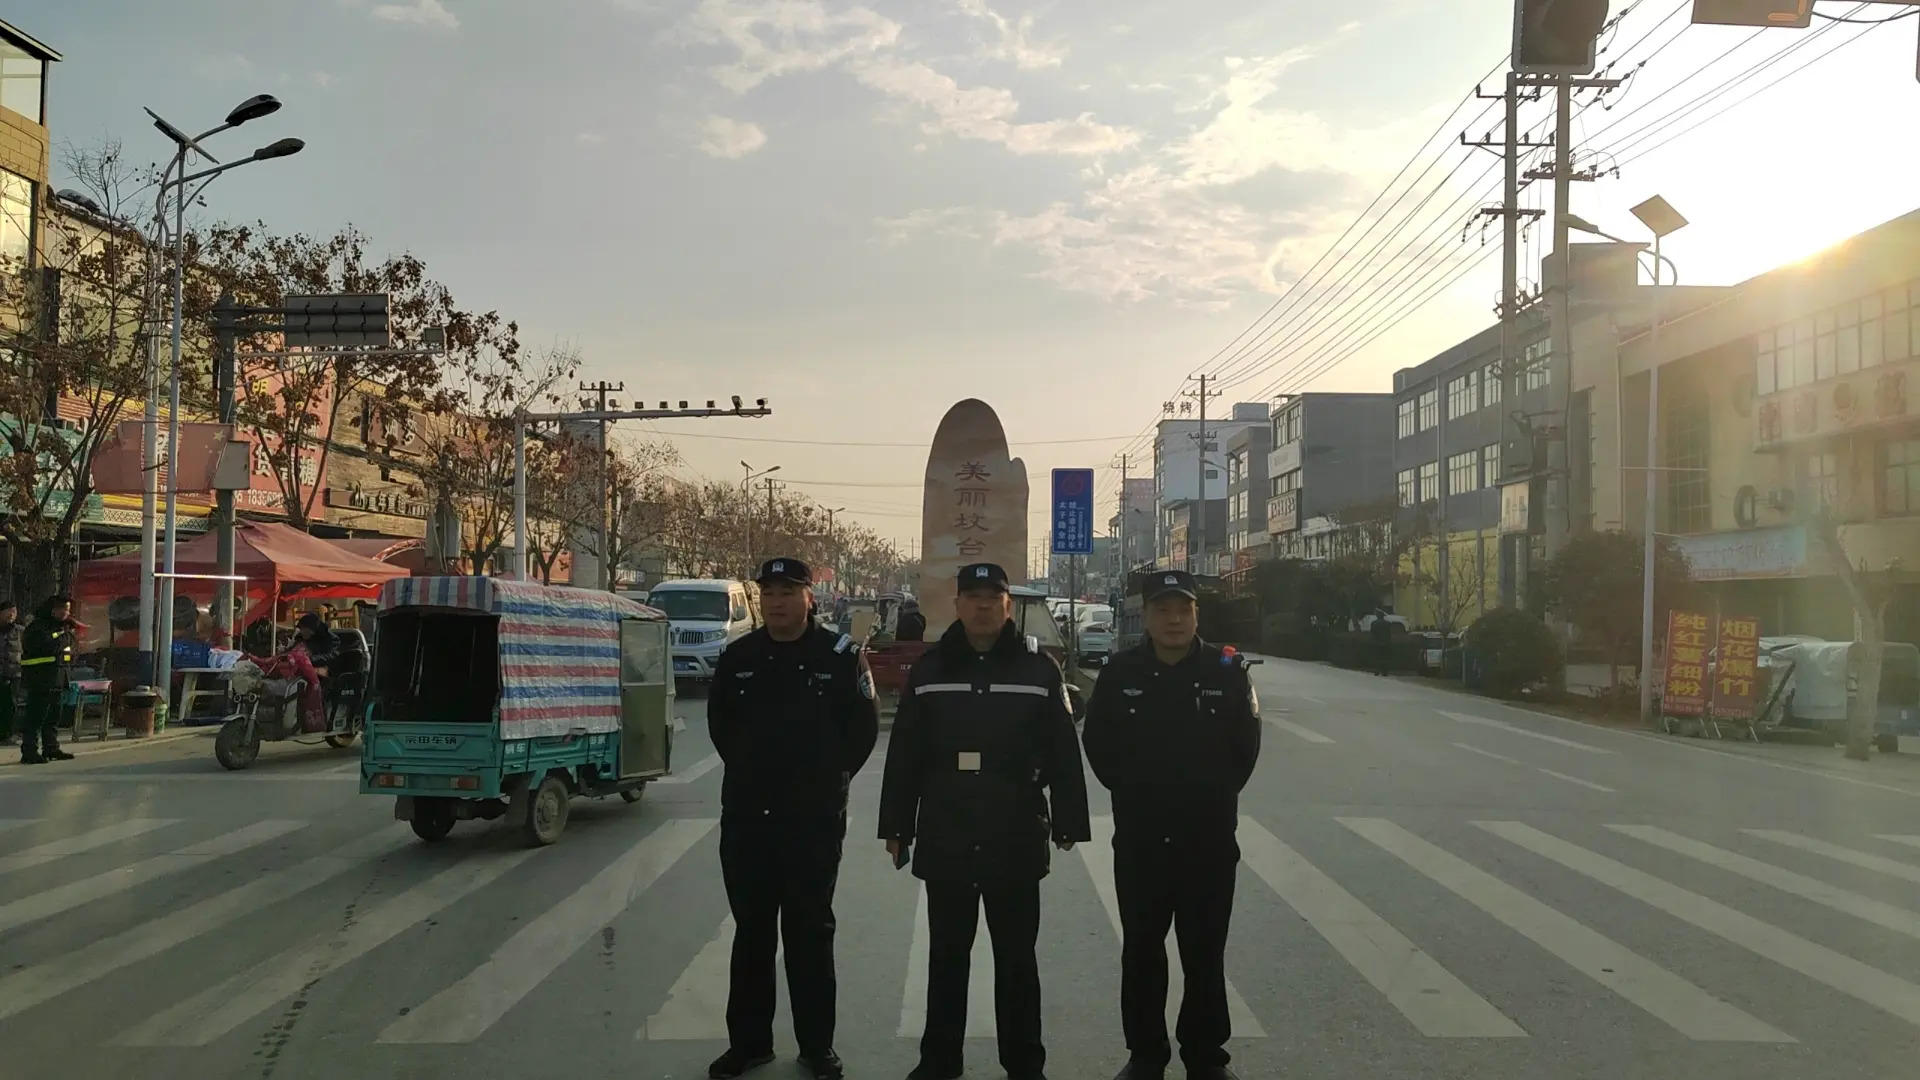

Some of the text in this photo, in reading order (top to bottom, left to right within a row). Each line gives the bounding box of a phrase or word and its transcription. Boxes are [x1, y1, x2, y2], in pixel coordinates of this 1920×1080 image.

[1162, 401, 1192, 414] 烧烤
[954, 461, 991, 556] 美丽坟台
[1718, 619, 1757, 696] 烟花爆竹
